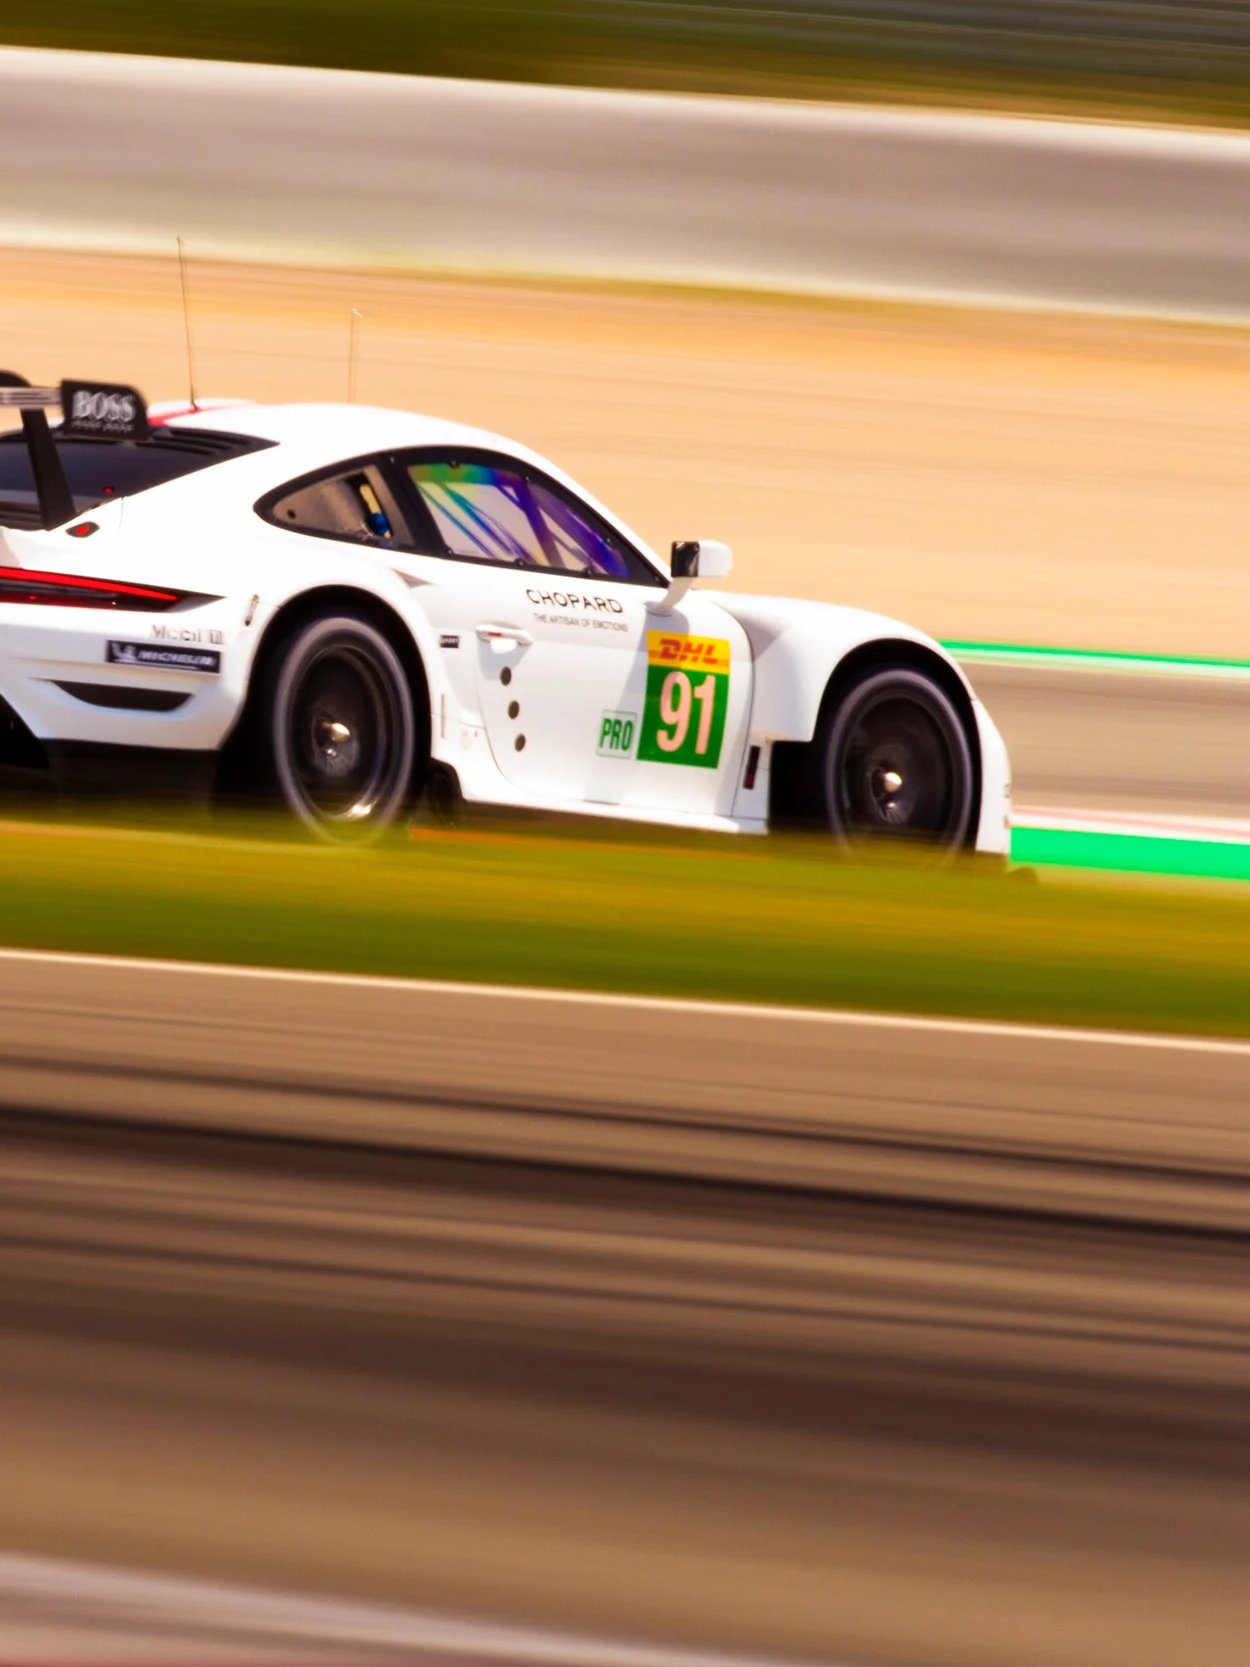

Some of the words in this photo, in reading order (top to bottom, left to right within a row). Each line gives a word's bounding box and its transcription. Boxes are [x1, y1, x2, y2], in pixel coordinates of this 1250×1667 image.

[71, 391, 136, 422] BOSS
[526, 589, 623, 613] CHOPARD
[137, 650, 217, 667] MICHELIN
[659, 638, 719, 664] DHL
[656, 670, 716, 755] 91
[598, 717, 634, 751] PRO
